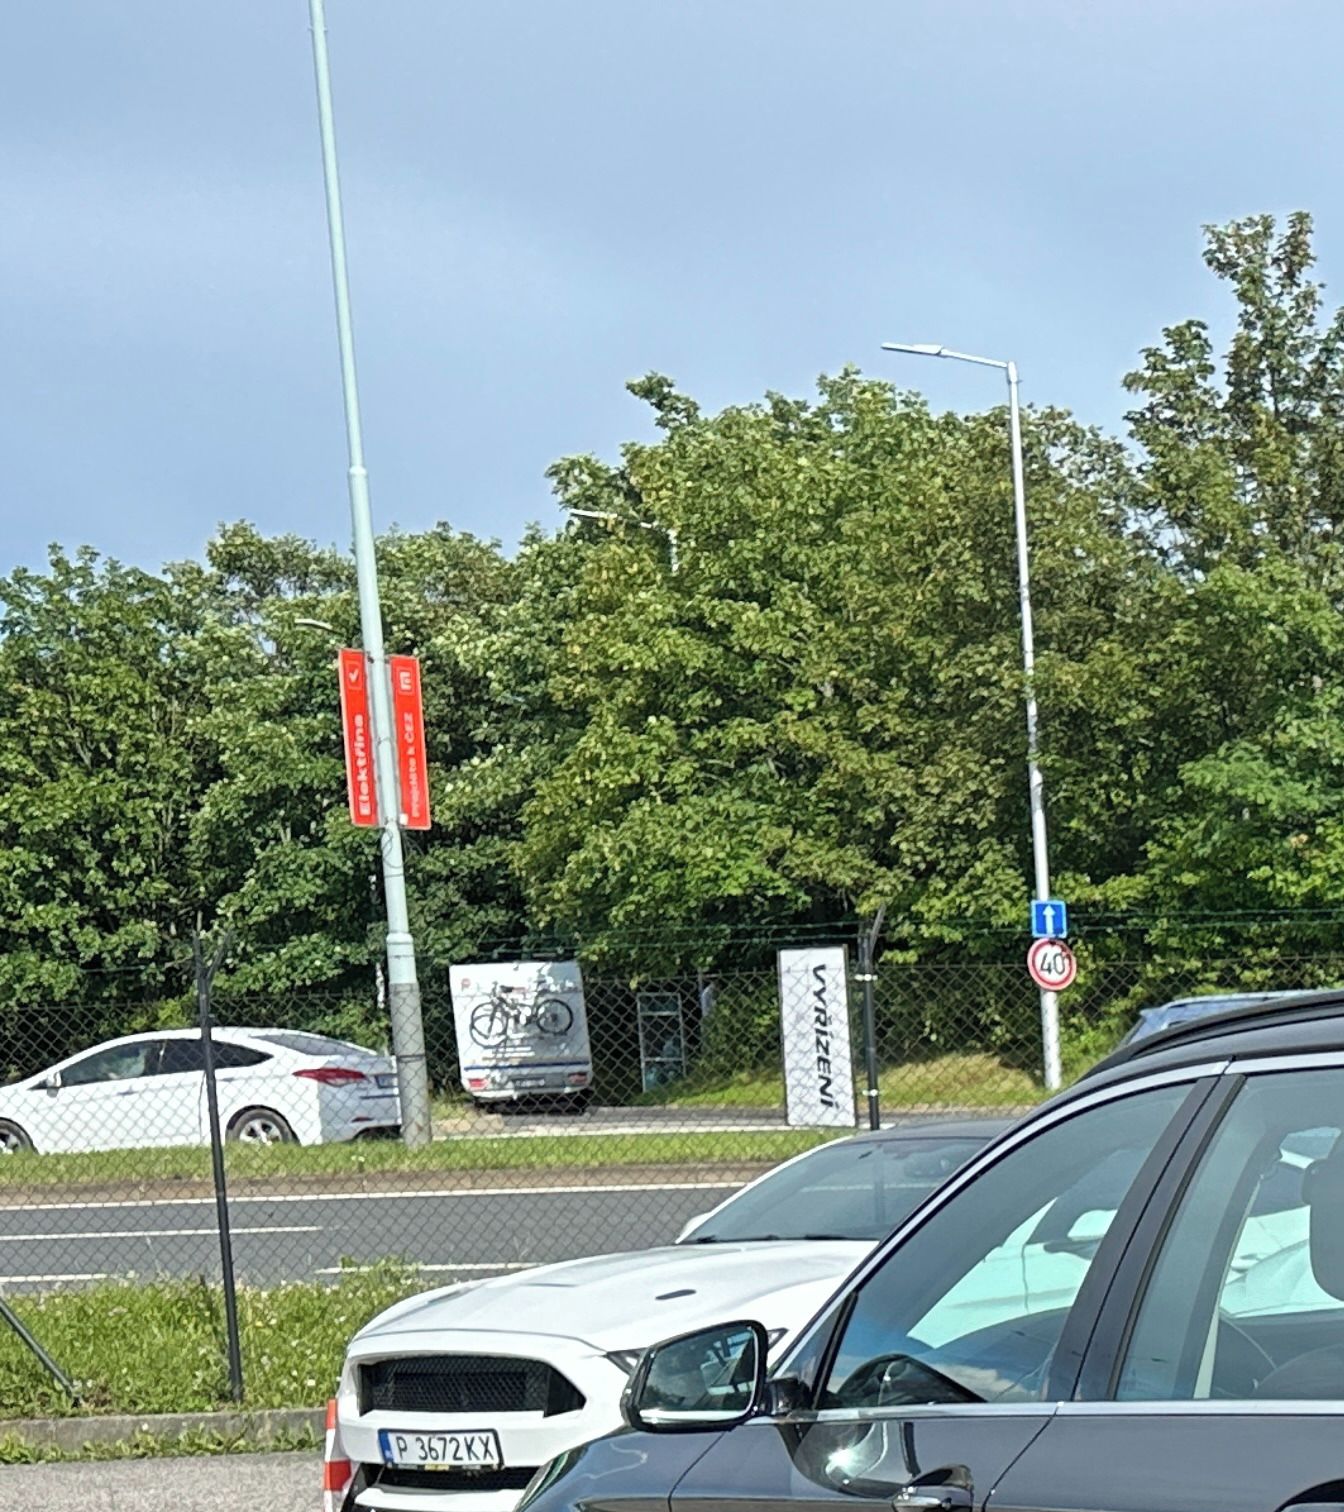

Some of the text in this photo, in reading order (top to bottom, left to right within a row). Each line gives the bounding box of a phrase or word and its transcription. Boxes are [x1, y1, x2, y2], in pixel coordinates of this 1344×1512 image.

[1040, 952, 1065, 975] 40
[812, 964, 840, 1109] VYŘÍZENÍ
[396, 1435, 494, 1461] P 3672KX
